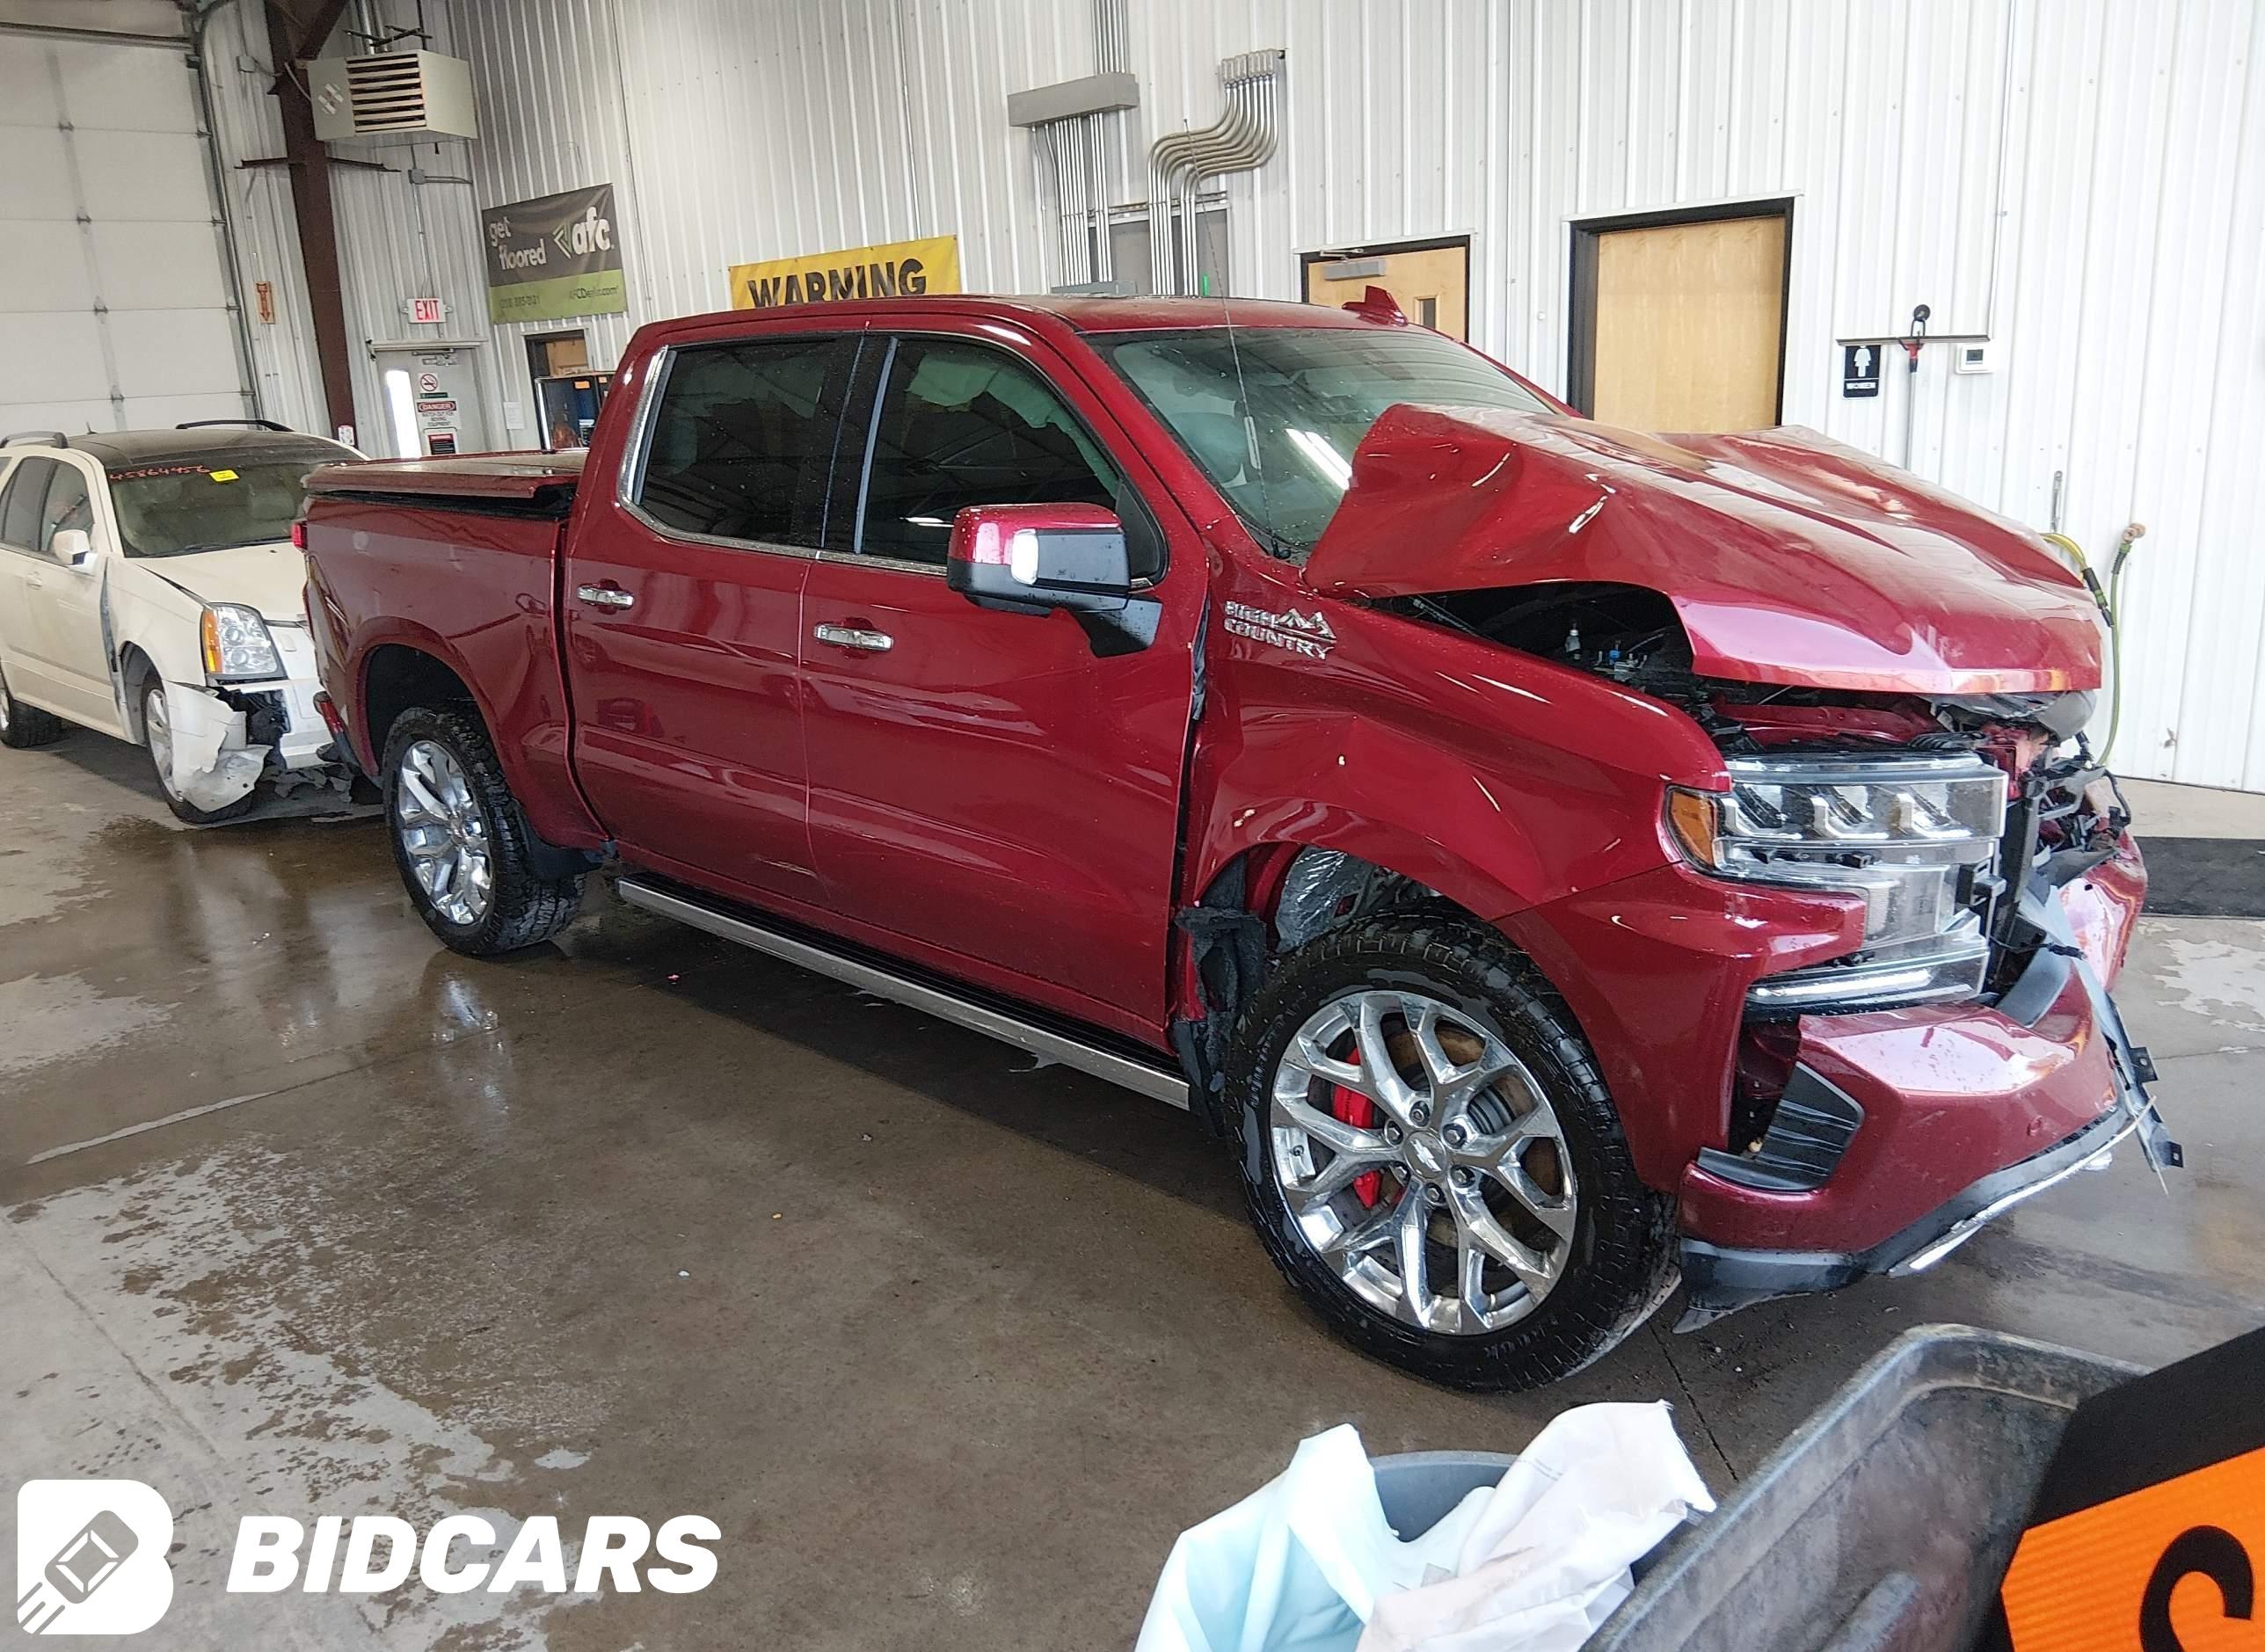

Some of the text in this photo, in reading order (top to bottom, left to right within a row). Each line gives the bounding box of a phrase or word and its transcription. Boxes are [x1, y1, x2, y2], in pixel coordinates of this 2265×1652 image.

[489, 217, 511, 247] get
[572, 207, 611, 255] afc
[499, 239, 547, 270] floored
[747, 258, 927, 308] WARNING
[415, 300, 440, 320] EXIT
[1224, 618, 1335, 659] COUNTRY
